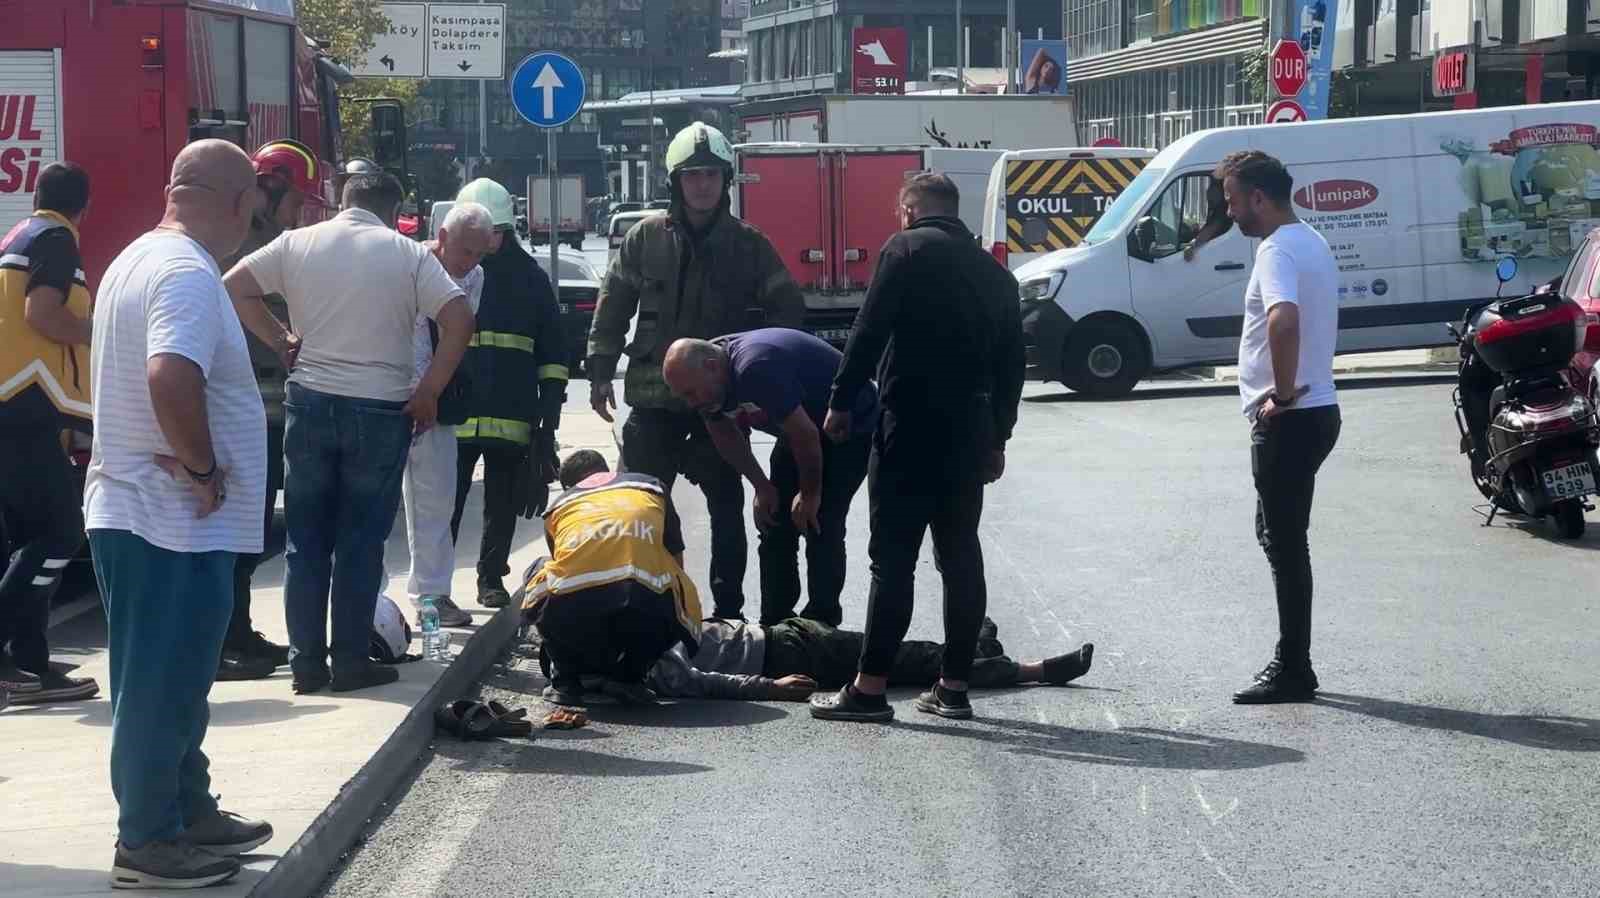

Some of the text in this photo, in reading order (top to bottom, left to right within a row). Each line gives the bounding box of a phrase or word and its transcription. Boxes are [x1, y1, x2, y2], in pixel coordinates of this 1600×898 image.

[384, 24, 418, 38] köy
[432, 28, 499, 39] Dolapdere
[432, 40, 481, 50] Taksim
[1274, 58, 1304, 79] DUR
[1435, 53, 1464, 90] OUTLET
[1317, 186, 1371, 204] unipak
[1017, 198, 1073, 214] OKUL
[1545, 471, 1564, 485] 34
[1556, 479, 1584, 495] 639
